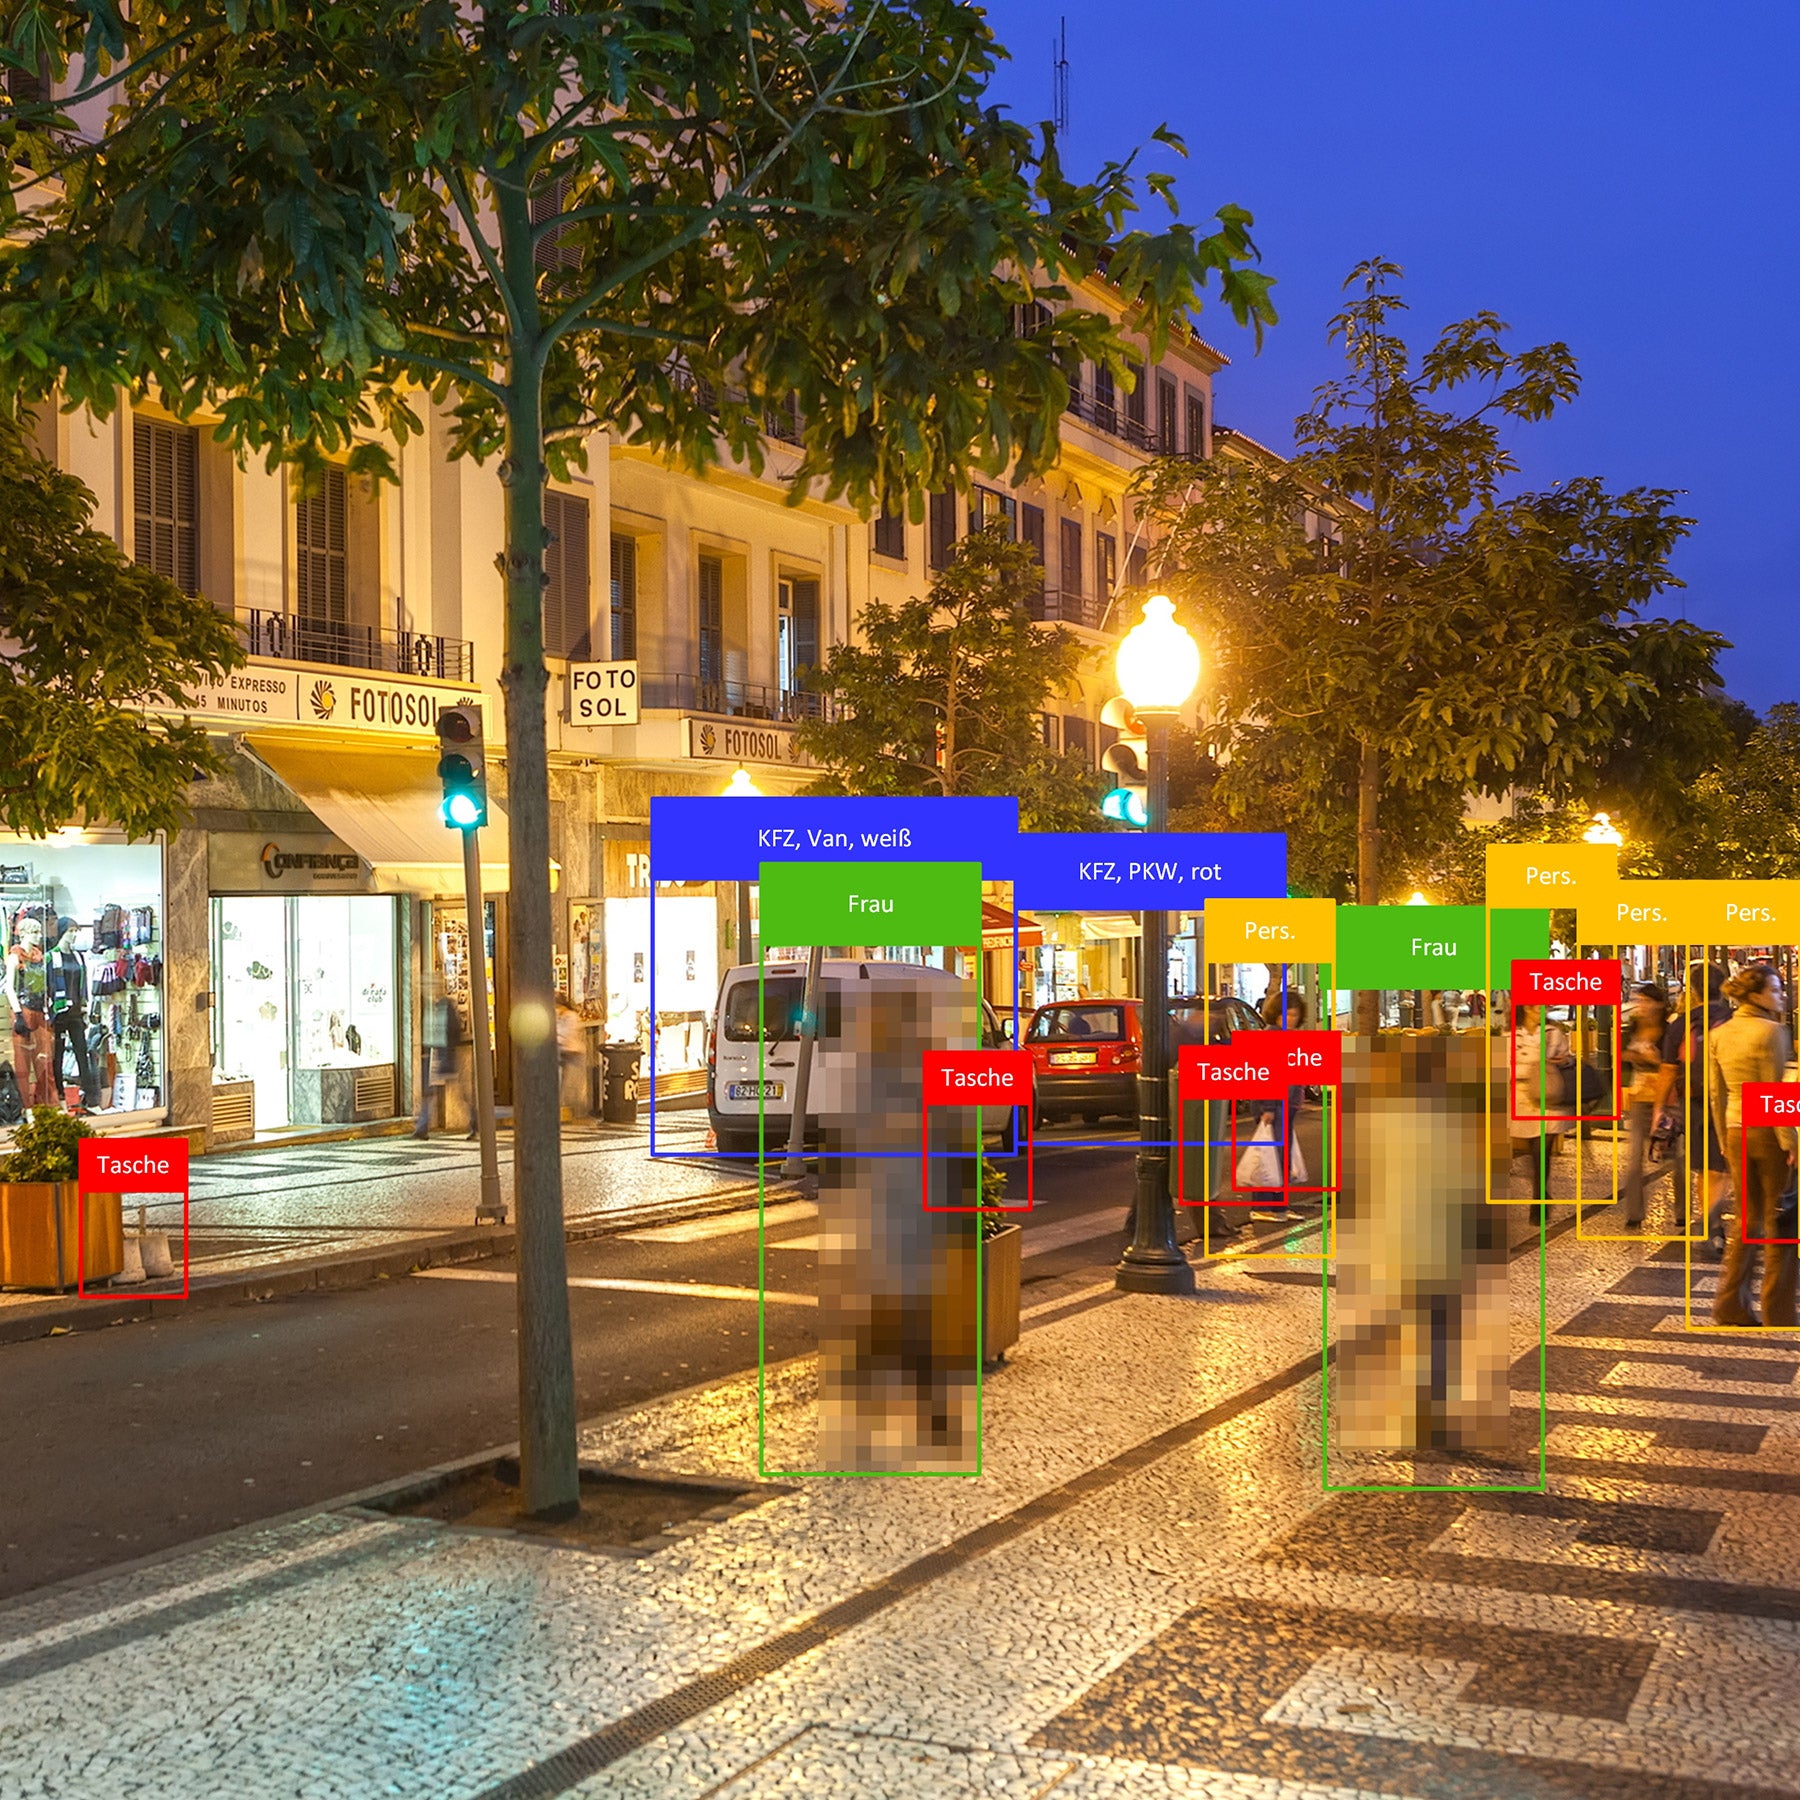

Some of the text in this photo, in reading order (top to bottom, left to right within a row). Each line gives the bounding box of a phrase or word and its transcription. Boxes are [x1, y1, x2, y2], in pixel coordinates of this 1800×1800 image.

[231, 676, 287, 694] EXPRESSO
[573, 669, 636, 690] FOTO
[217, 696, 268, 713] MINUTOS
[580, 698, 627, 717] SOL
[725, 729, 781, 759] FOTOSOL
